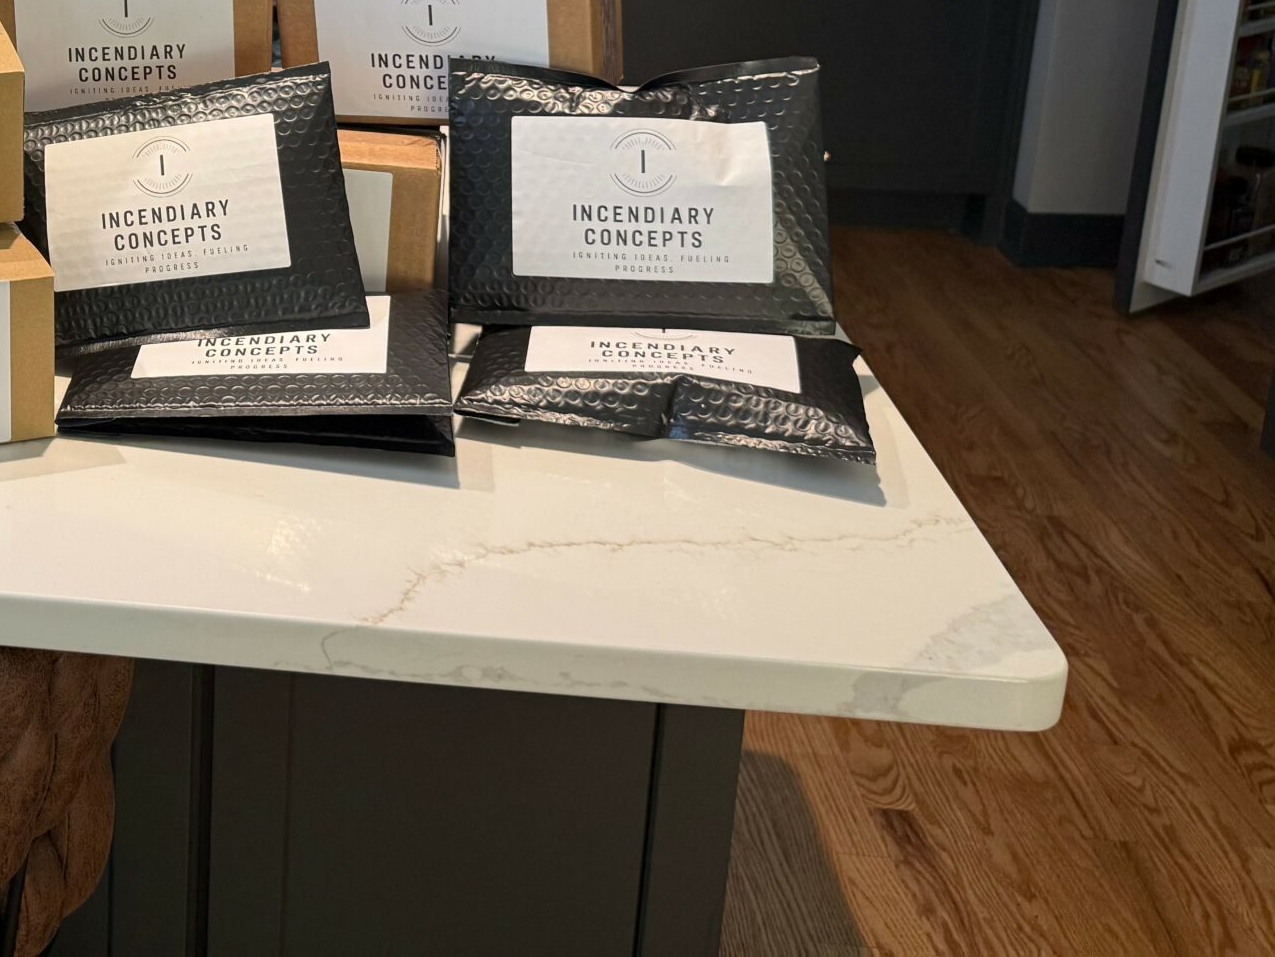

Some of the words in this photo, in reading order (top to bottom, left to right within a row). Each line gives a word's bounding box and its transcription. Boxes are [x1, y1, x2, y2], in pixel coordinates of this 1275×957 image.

[68, 43, 186, 63] INCENDIARY
[371, 53, 495, 71] INCEND
[78, 64, 177, 82] CONCEPTS
[382, 74, 448, 91] CONCE
[410, 105, 449, 113] PROGRE
[101, 198, 231, 230] INCENDIARY
[572, 204, 715, 226] INCENDIARY
[114, 223, 222, 251] CONCEPTS
[584, 228, 703, 249] CONCEPTS
[197, 333, 331, 347] INCENDIARY
[590, 341, 736, 355] INCENDIARY
[205, 345, 318, 357] CONCEPTS
[602, 350, 724, 363] CONCEPTS
